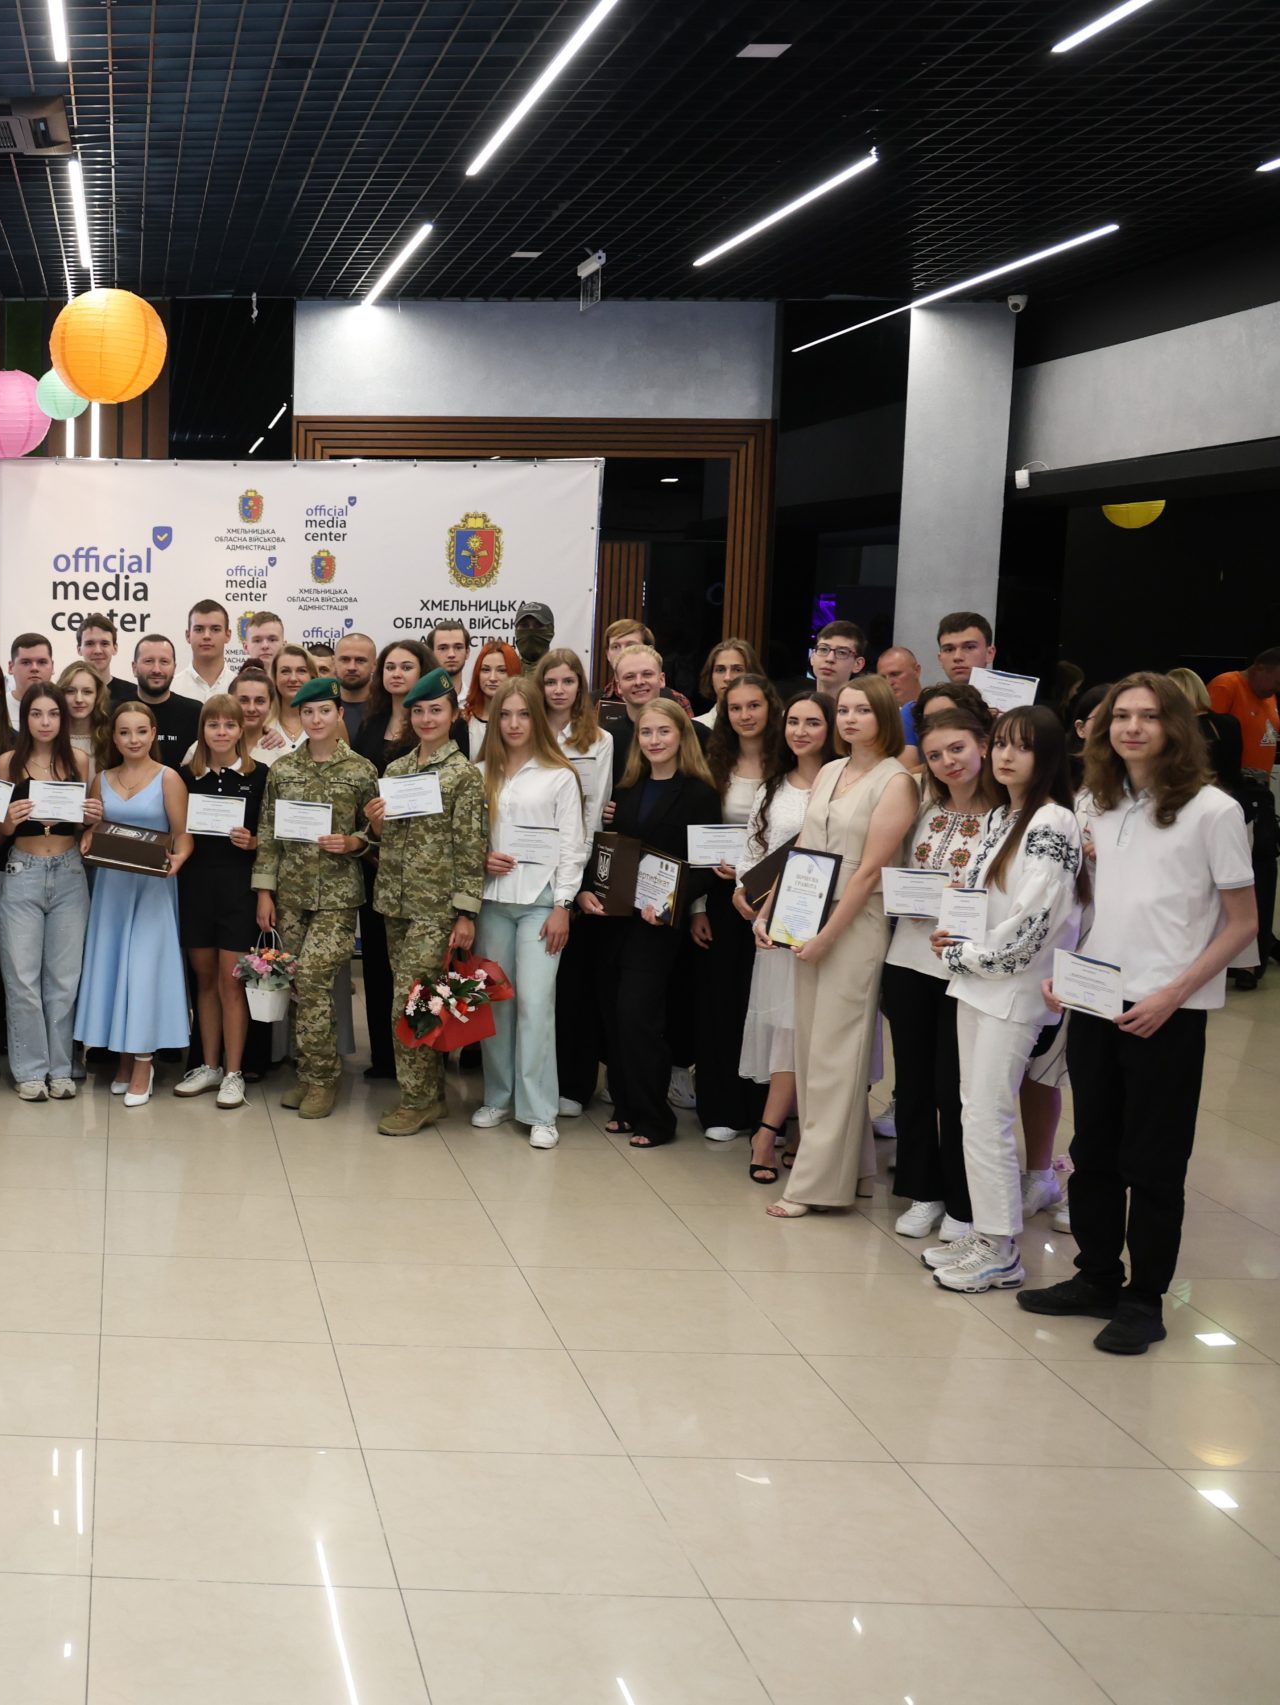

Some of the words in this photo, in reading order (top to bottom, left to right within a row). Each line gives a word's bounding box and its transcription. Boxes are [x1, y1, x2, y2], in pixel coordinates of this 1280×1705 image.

[306, 505, 348, 517] official
[305, 516, 347, 528] media
[249, 535, 286, 543] ВІЙСЬКОВА
[304, 530, 348, 542] center
[53, 546, 152, 574] official
[226, 565, 268, 577] official
[52, 573, 149, 602] media
[225, 577, 267, 589] media
[225, 591, 268, 602] center
[298, 588, 348, 596] ХМЕЛЬНИЦЬКА
[320, 596, 358, 604] ВІЙСЬКОВА
[298, 604, 349, 612] АДМІНІСТРАЦІЯ
[51, 609, 151, 632] ceter
[303, 627, 345, 638] official
